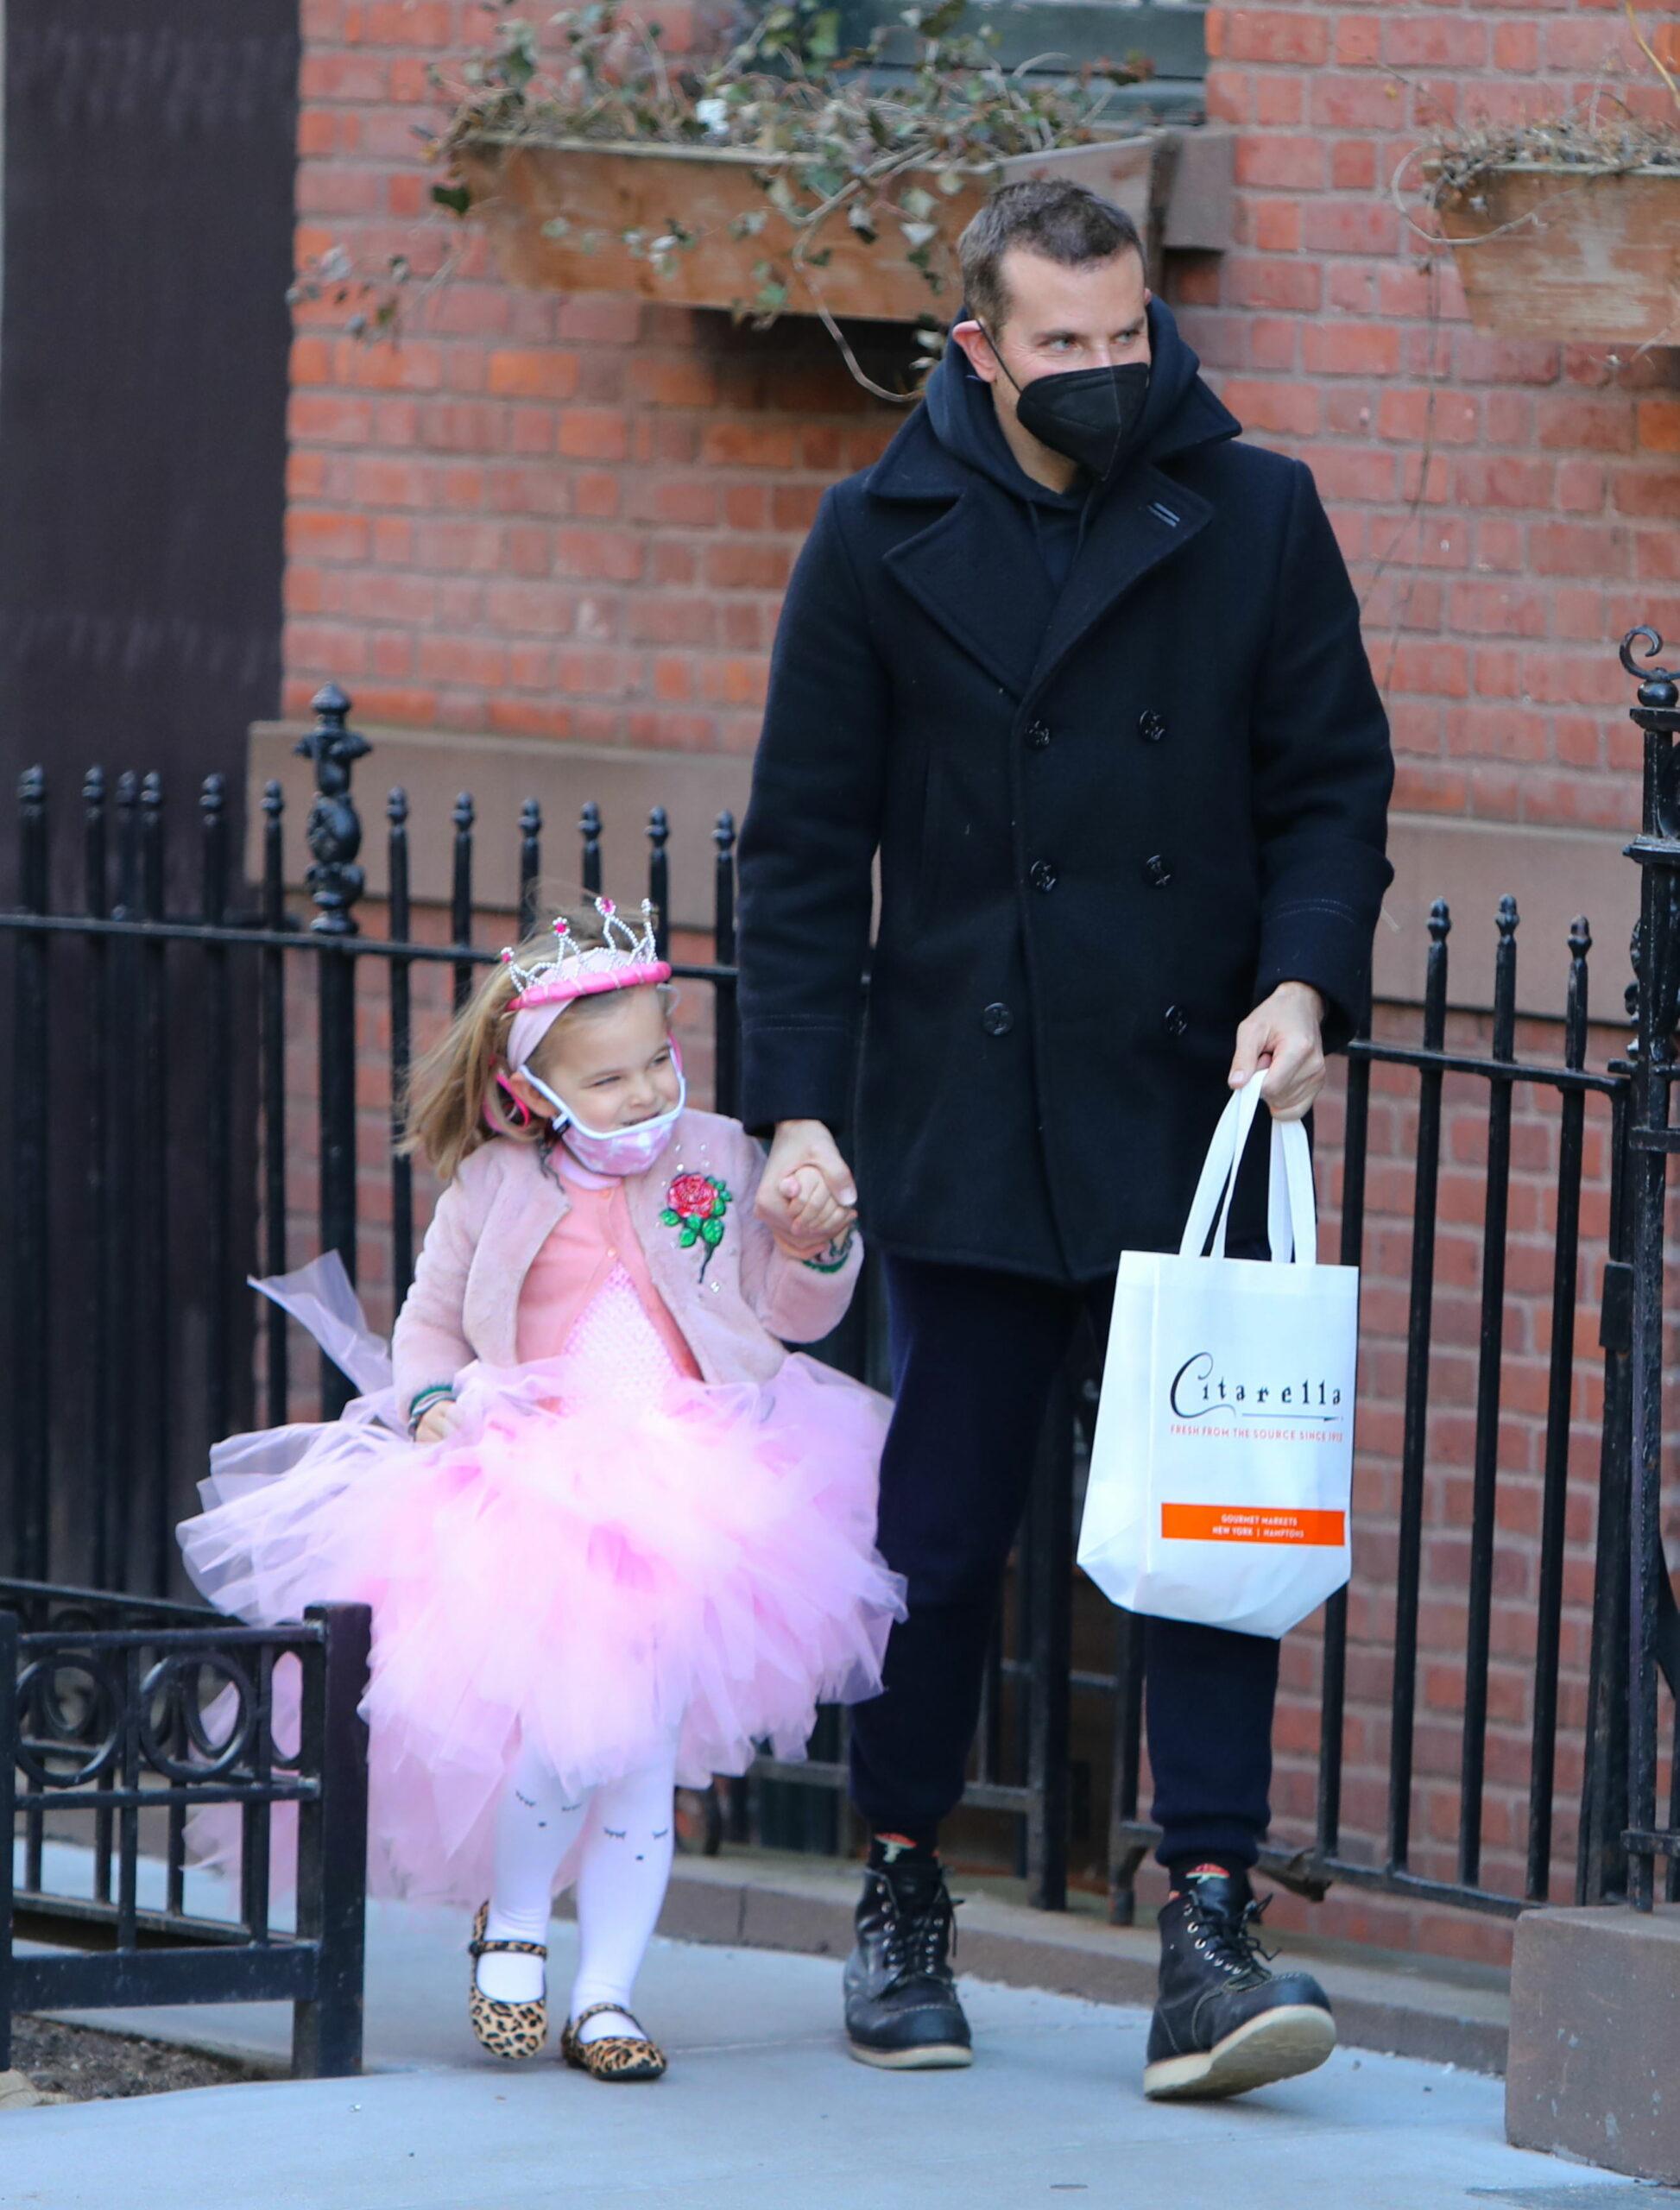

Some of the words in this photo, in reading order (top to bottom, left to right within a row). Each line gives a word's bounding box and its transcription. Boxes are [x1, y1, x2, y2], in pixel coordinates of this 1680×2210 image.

[1170, 1352, 1342, 1418] Citarella
[1171, 1424, 1199, 1436] FRESH
[1203, 1426, 1229, 1437] FROM
[1234, 1428, 1249, 1438] THE
[1254, 1429, 1295, 1441] SOURCE
[1299, 1430, 1325, 1442] SINCE
[1221, 1514, 1260, 1525] GOURMET
[1261, 1517, 1298, 1526] MARKETS
[1212, 1526, 1230, 1535] NEW
[1232, 1526, 1254, 1537] YORK
[1263, 1528, 1304, 1538] HAMPTONS
